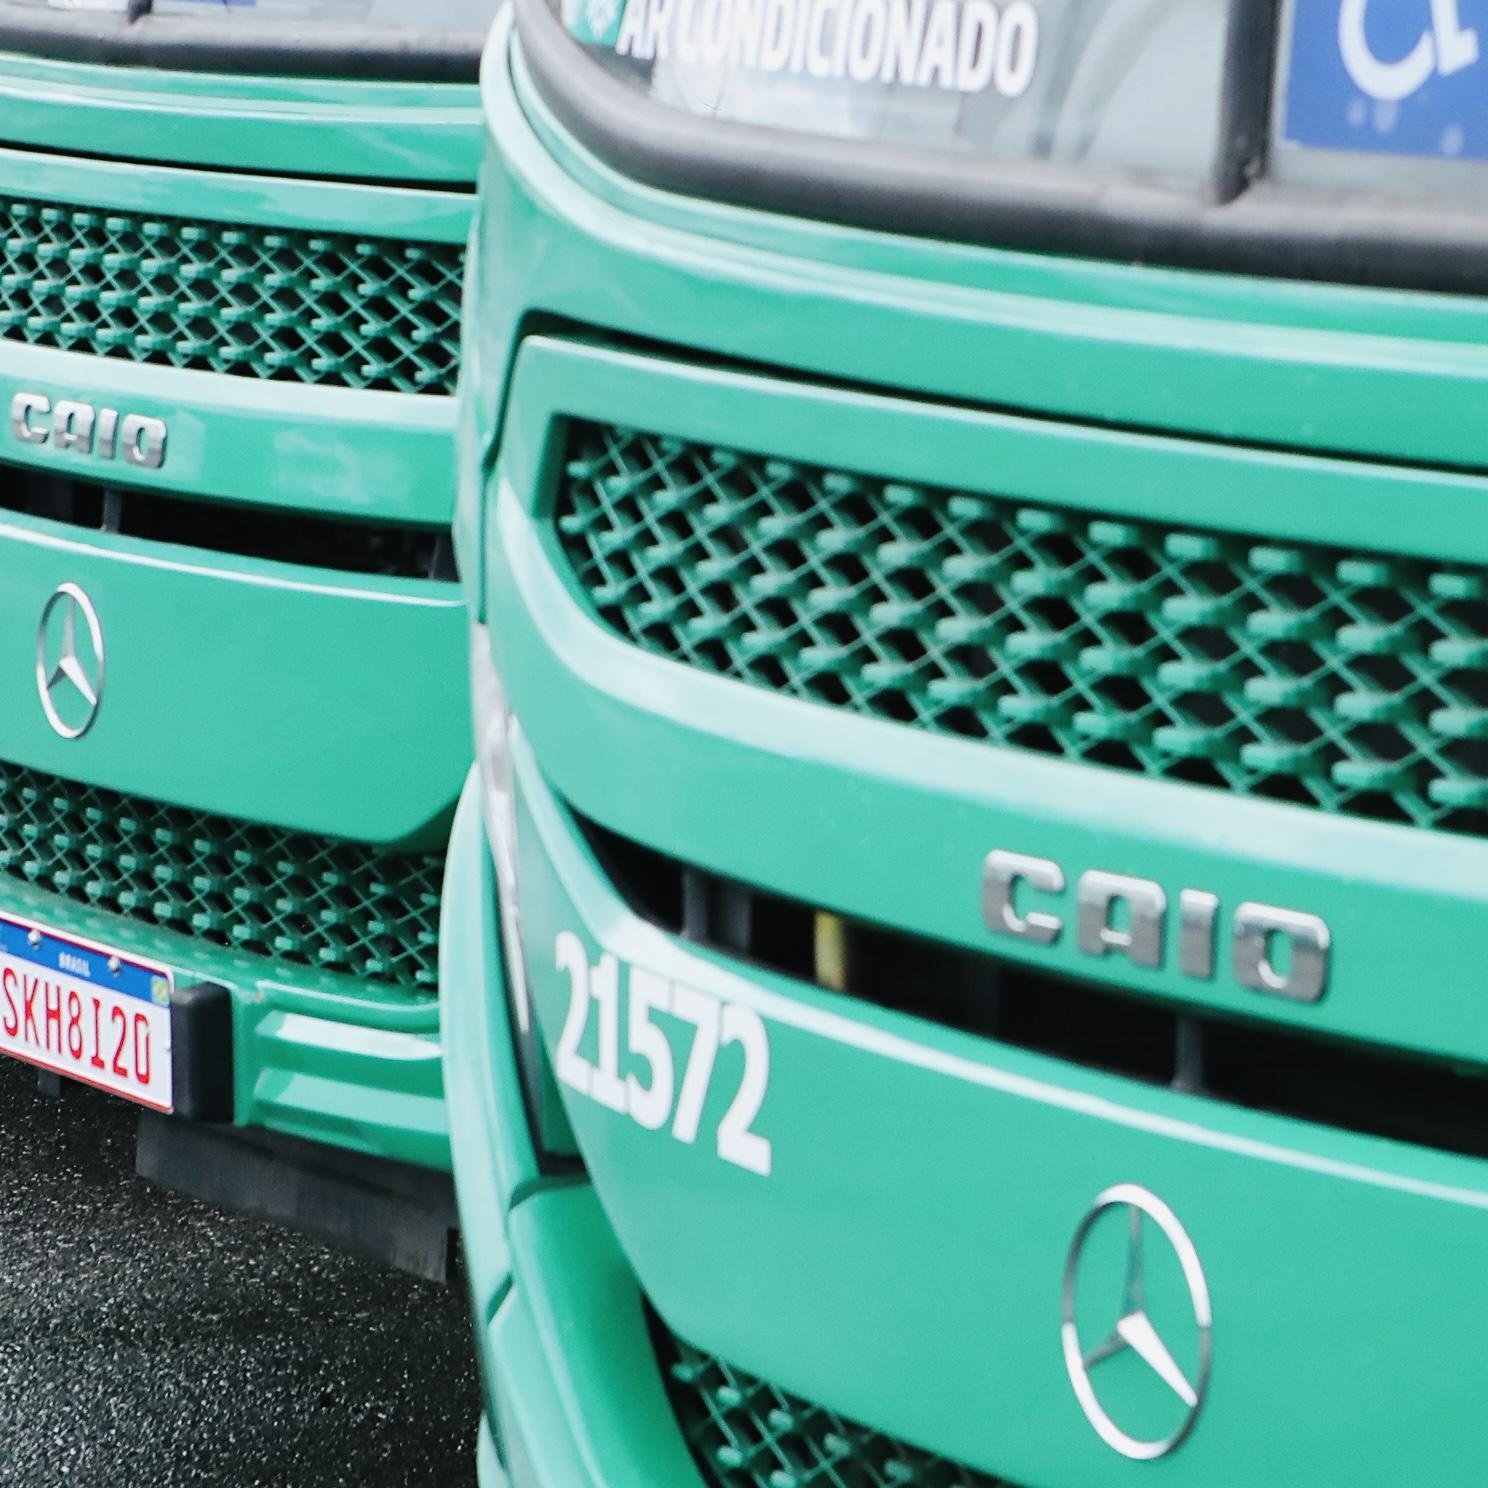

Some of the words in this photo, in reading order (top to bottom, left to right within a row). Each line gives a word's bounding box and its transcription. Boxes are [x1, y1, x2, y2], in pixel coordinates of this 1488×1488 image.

[11, 391, 169, 470] CAIO
[981, 849, 1331, 1005] CAIO
[554, 930, 773, 1177] 21572
